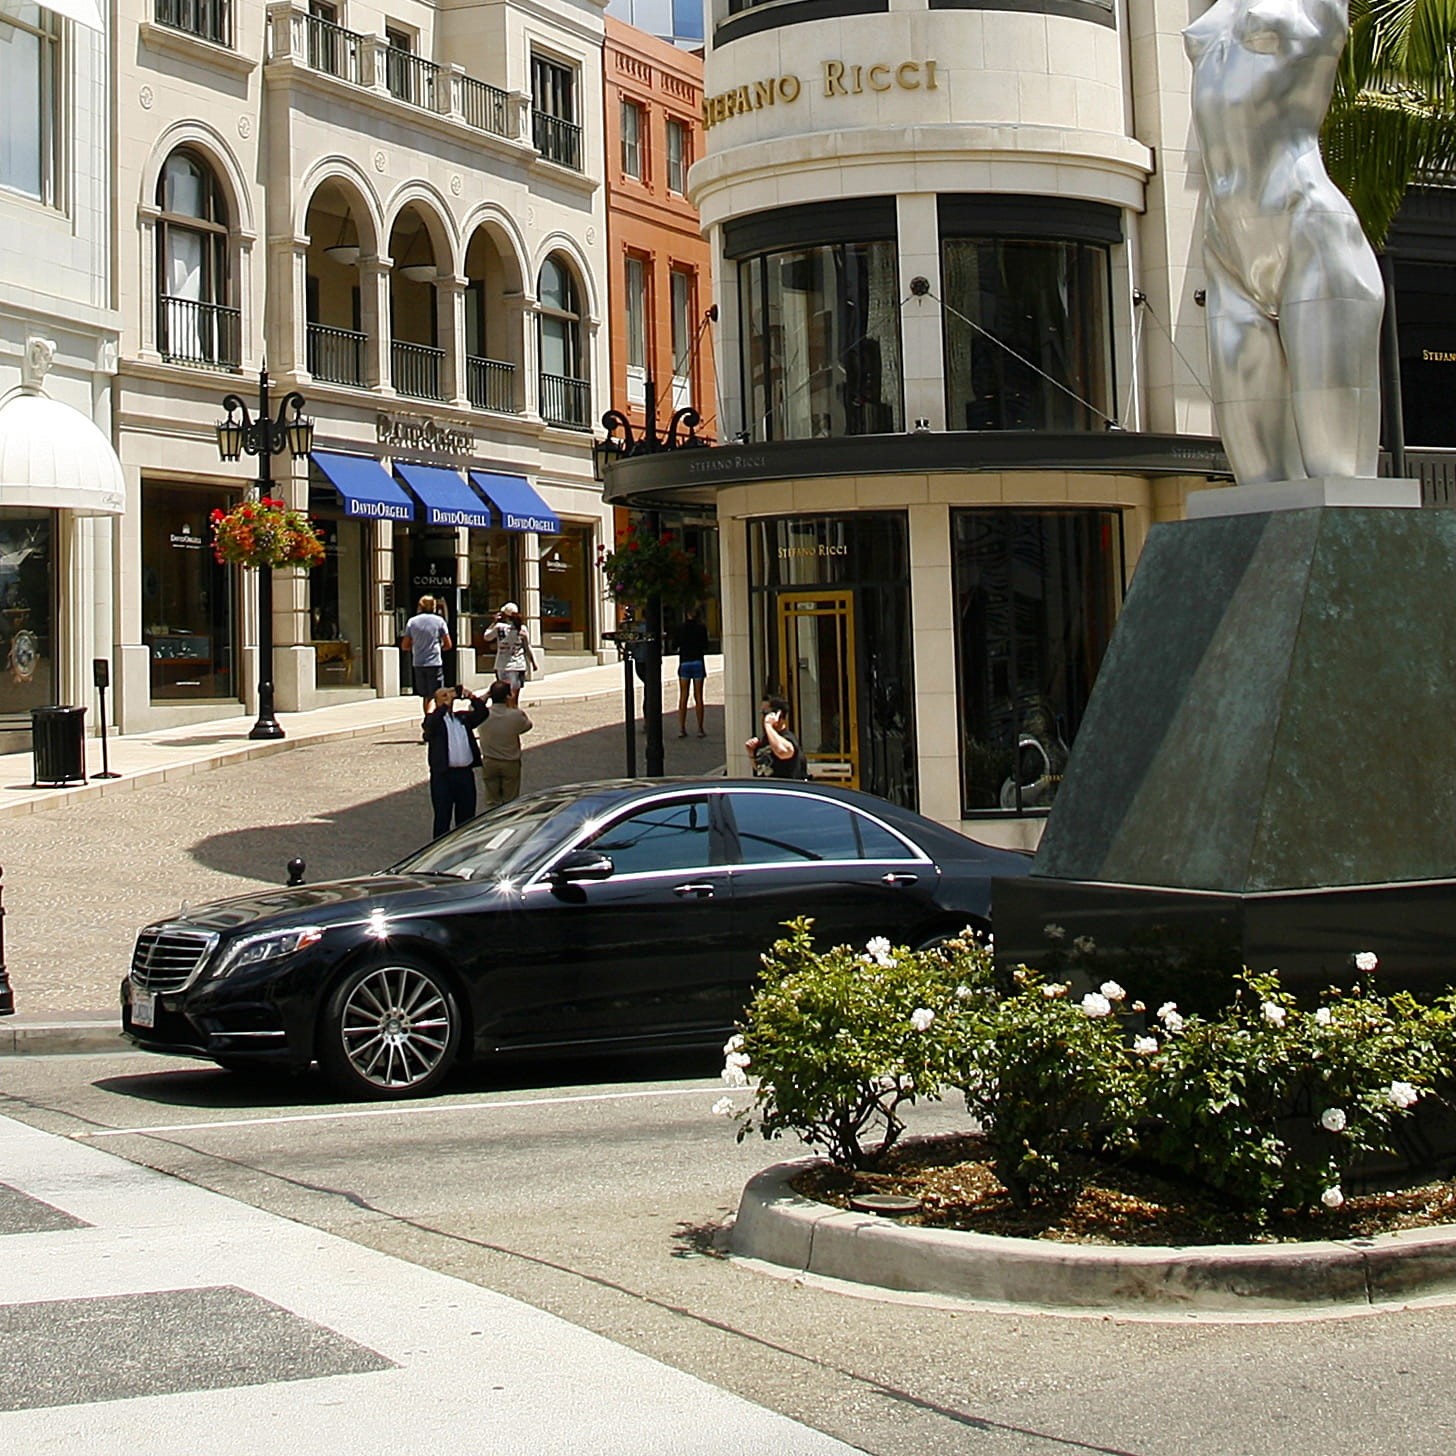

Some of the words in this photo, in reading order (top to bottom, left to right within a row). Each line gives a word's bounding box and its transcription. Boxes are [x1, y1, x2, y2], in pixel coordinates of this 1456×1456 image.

[821, 60, 938, 97] RICCI
[818, 545, 847, 556] RICCI
[413, 575, 452, 585] CORUM
